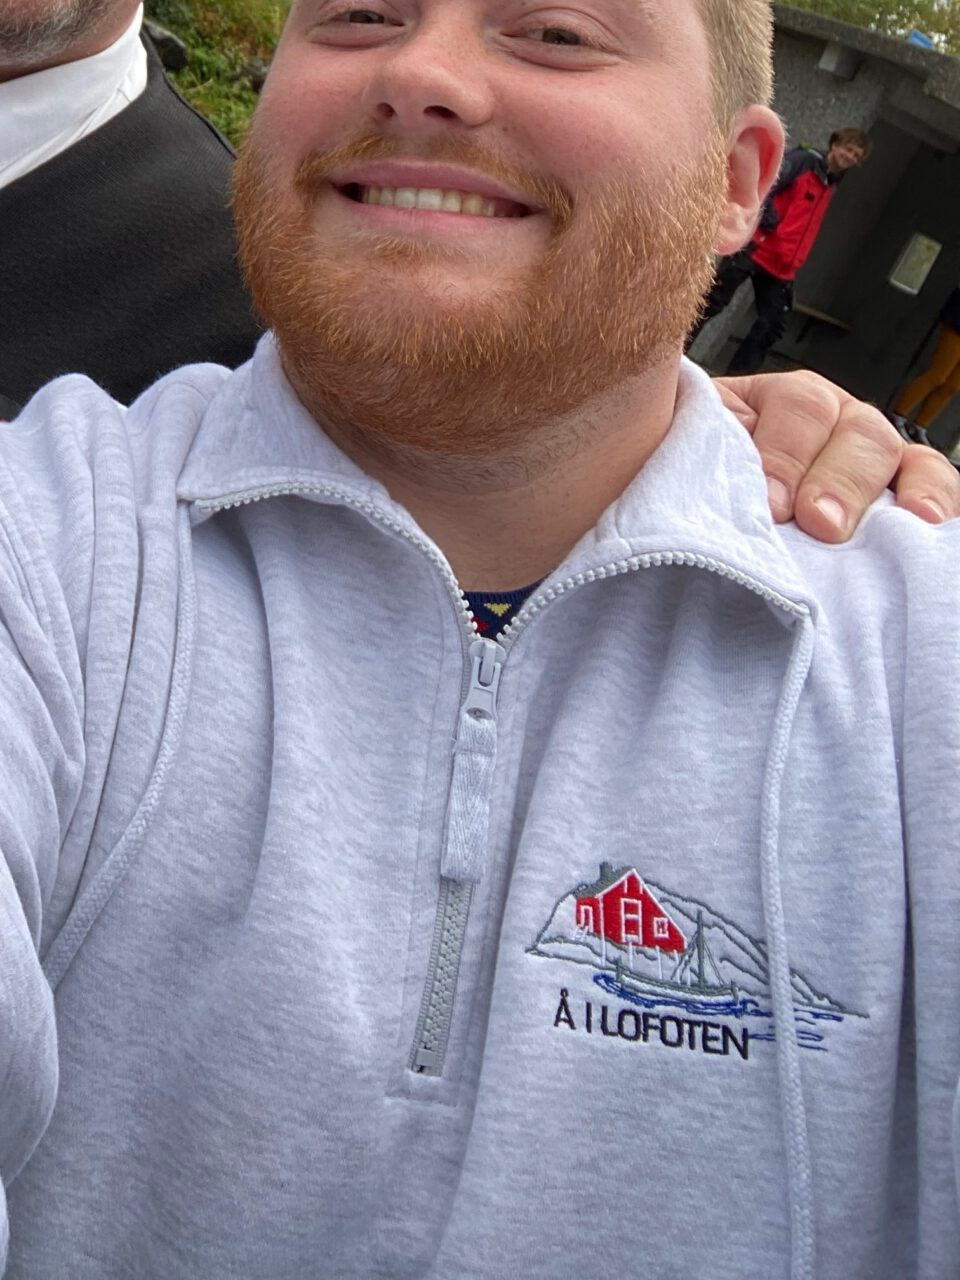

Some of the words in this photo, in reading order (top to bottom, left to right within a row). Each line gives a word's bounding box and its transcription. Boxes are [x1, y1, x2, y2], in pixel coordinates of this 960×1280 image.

[553, 987, 577, 1030] Å
[585, 1001, 593, 1034] I
[600, 1005, 750, 1060] LOFOTEN
